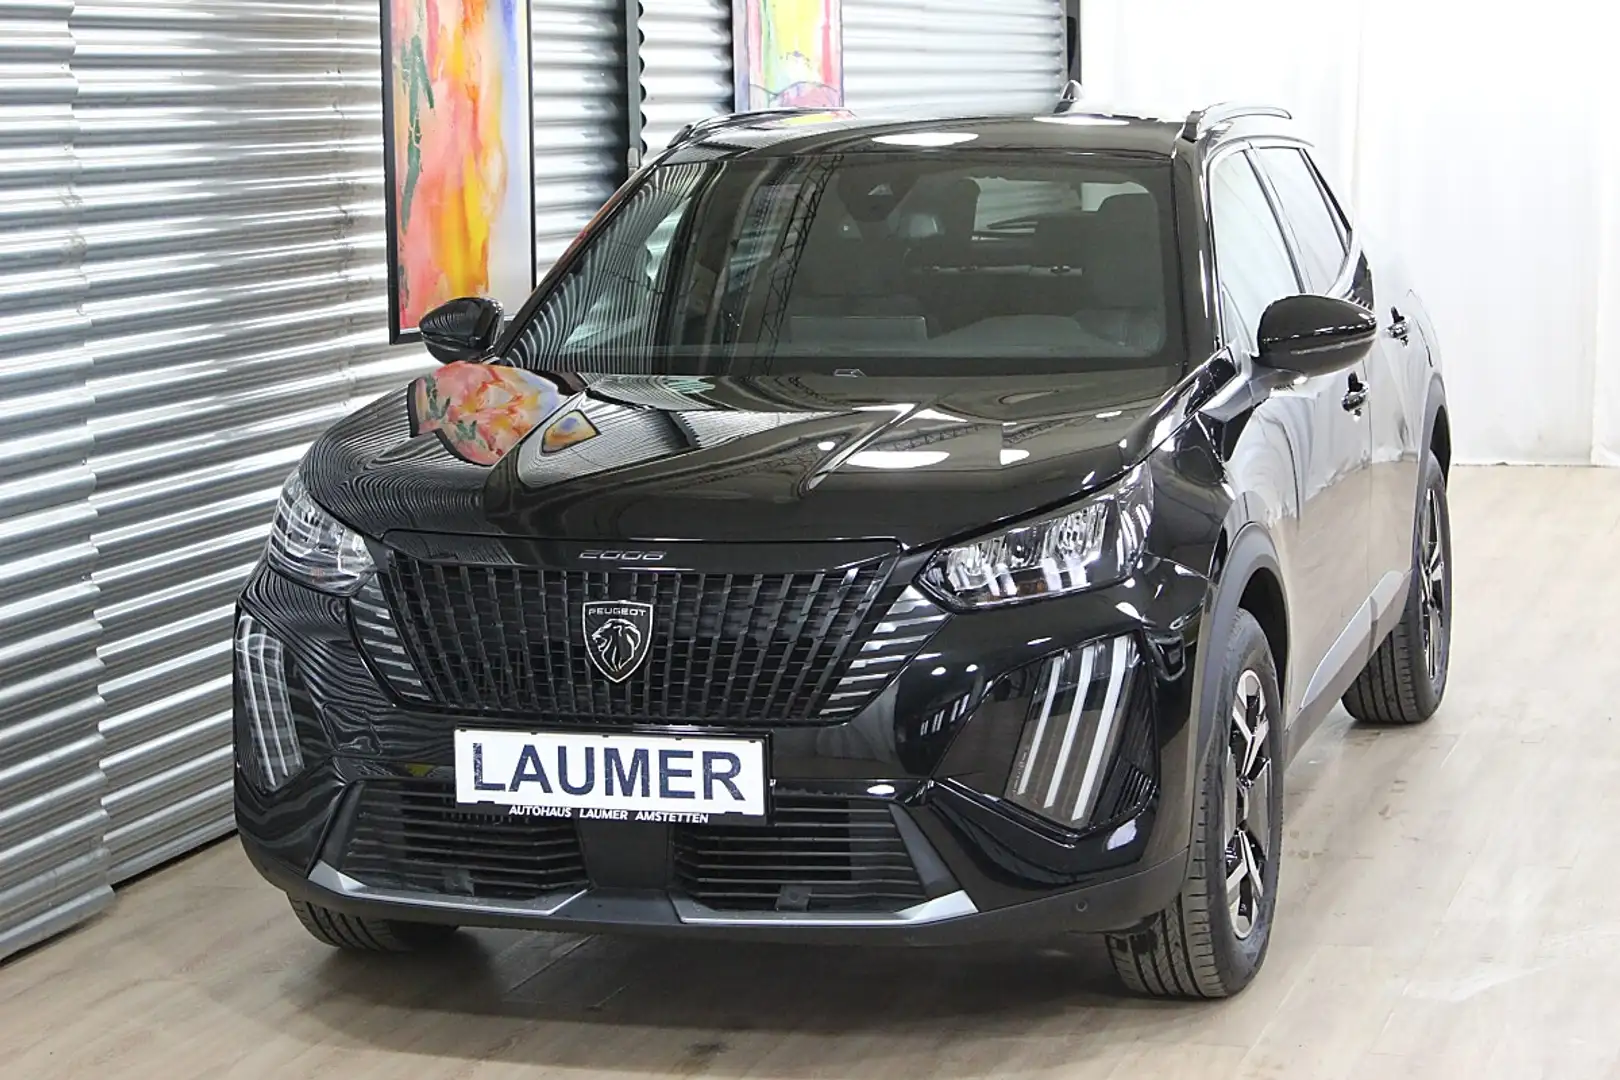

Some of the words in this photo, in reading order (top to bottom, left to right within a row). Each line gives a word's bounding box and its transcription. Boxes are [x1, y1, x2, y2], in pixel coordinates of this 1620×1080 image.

[588, 607, 647, 617] PEUGEOT
[473, 742, 746, 801] LAUMER
[508, 804, 572, 818] AUTOHAUS
[579, 807, 629, 821] LAUMER
[635, 810, 709, 824] AMSTETTEN
